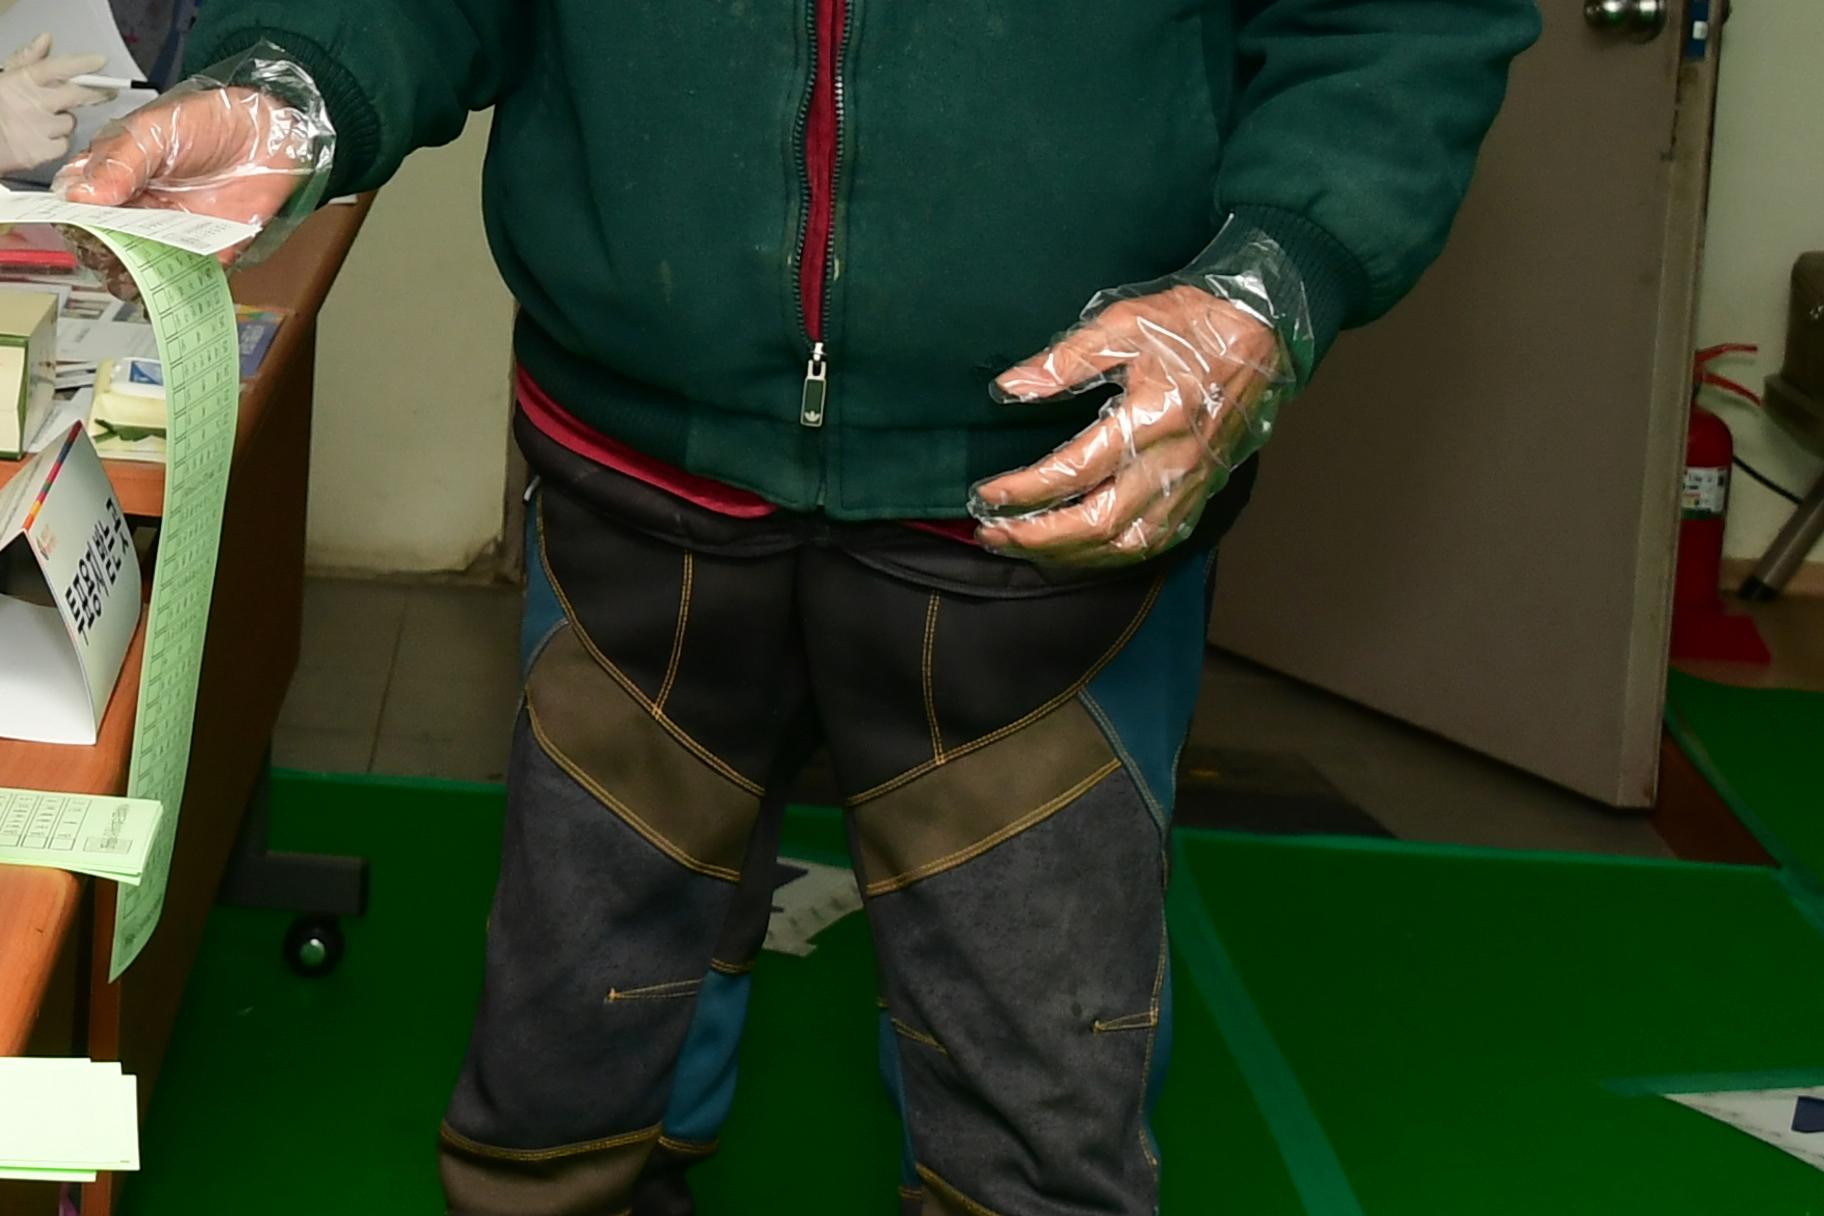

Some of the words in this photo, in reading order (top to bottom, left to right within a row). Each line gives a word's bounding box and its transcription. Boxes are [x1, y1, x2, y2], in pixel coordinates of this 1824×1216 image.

[92, 520, 122, 586] 받는
[106, 497, 129, 555] 곳
[65, 540, 110, 646] 투표용지
